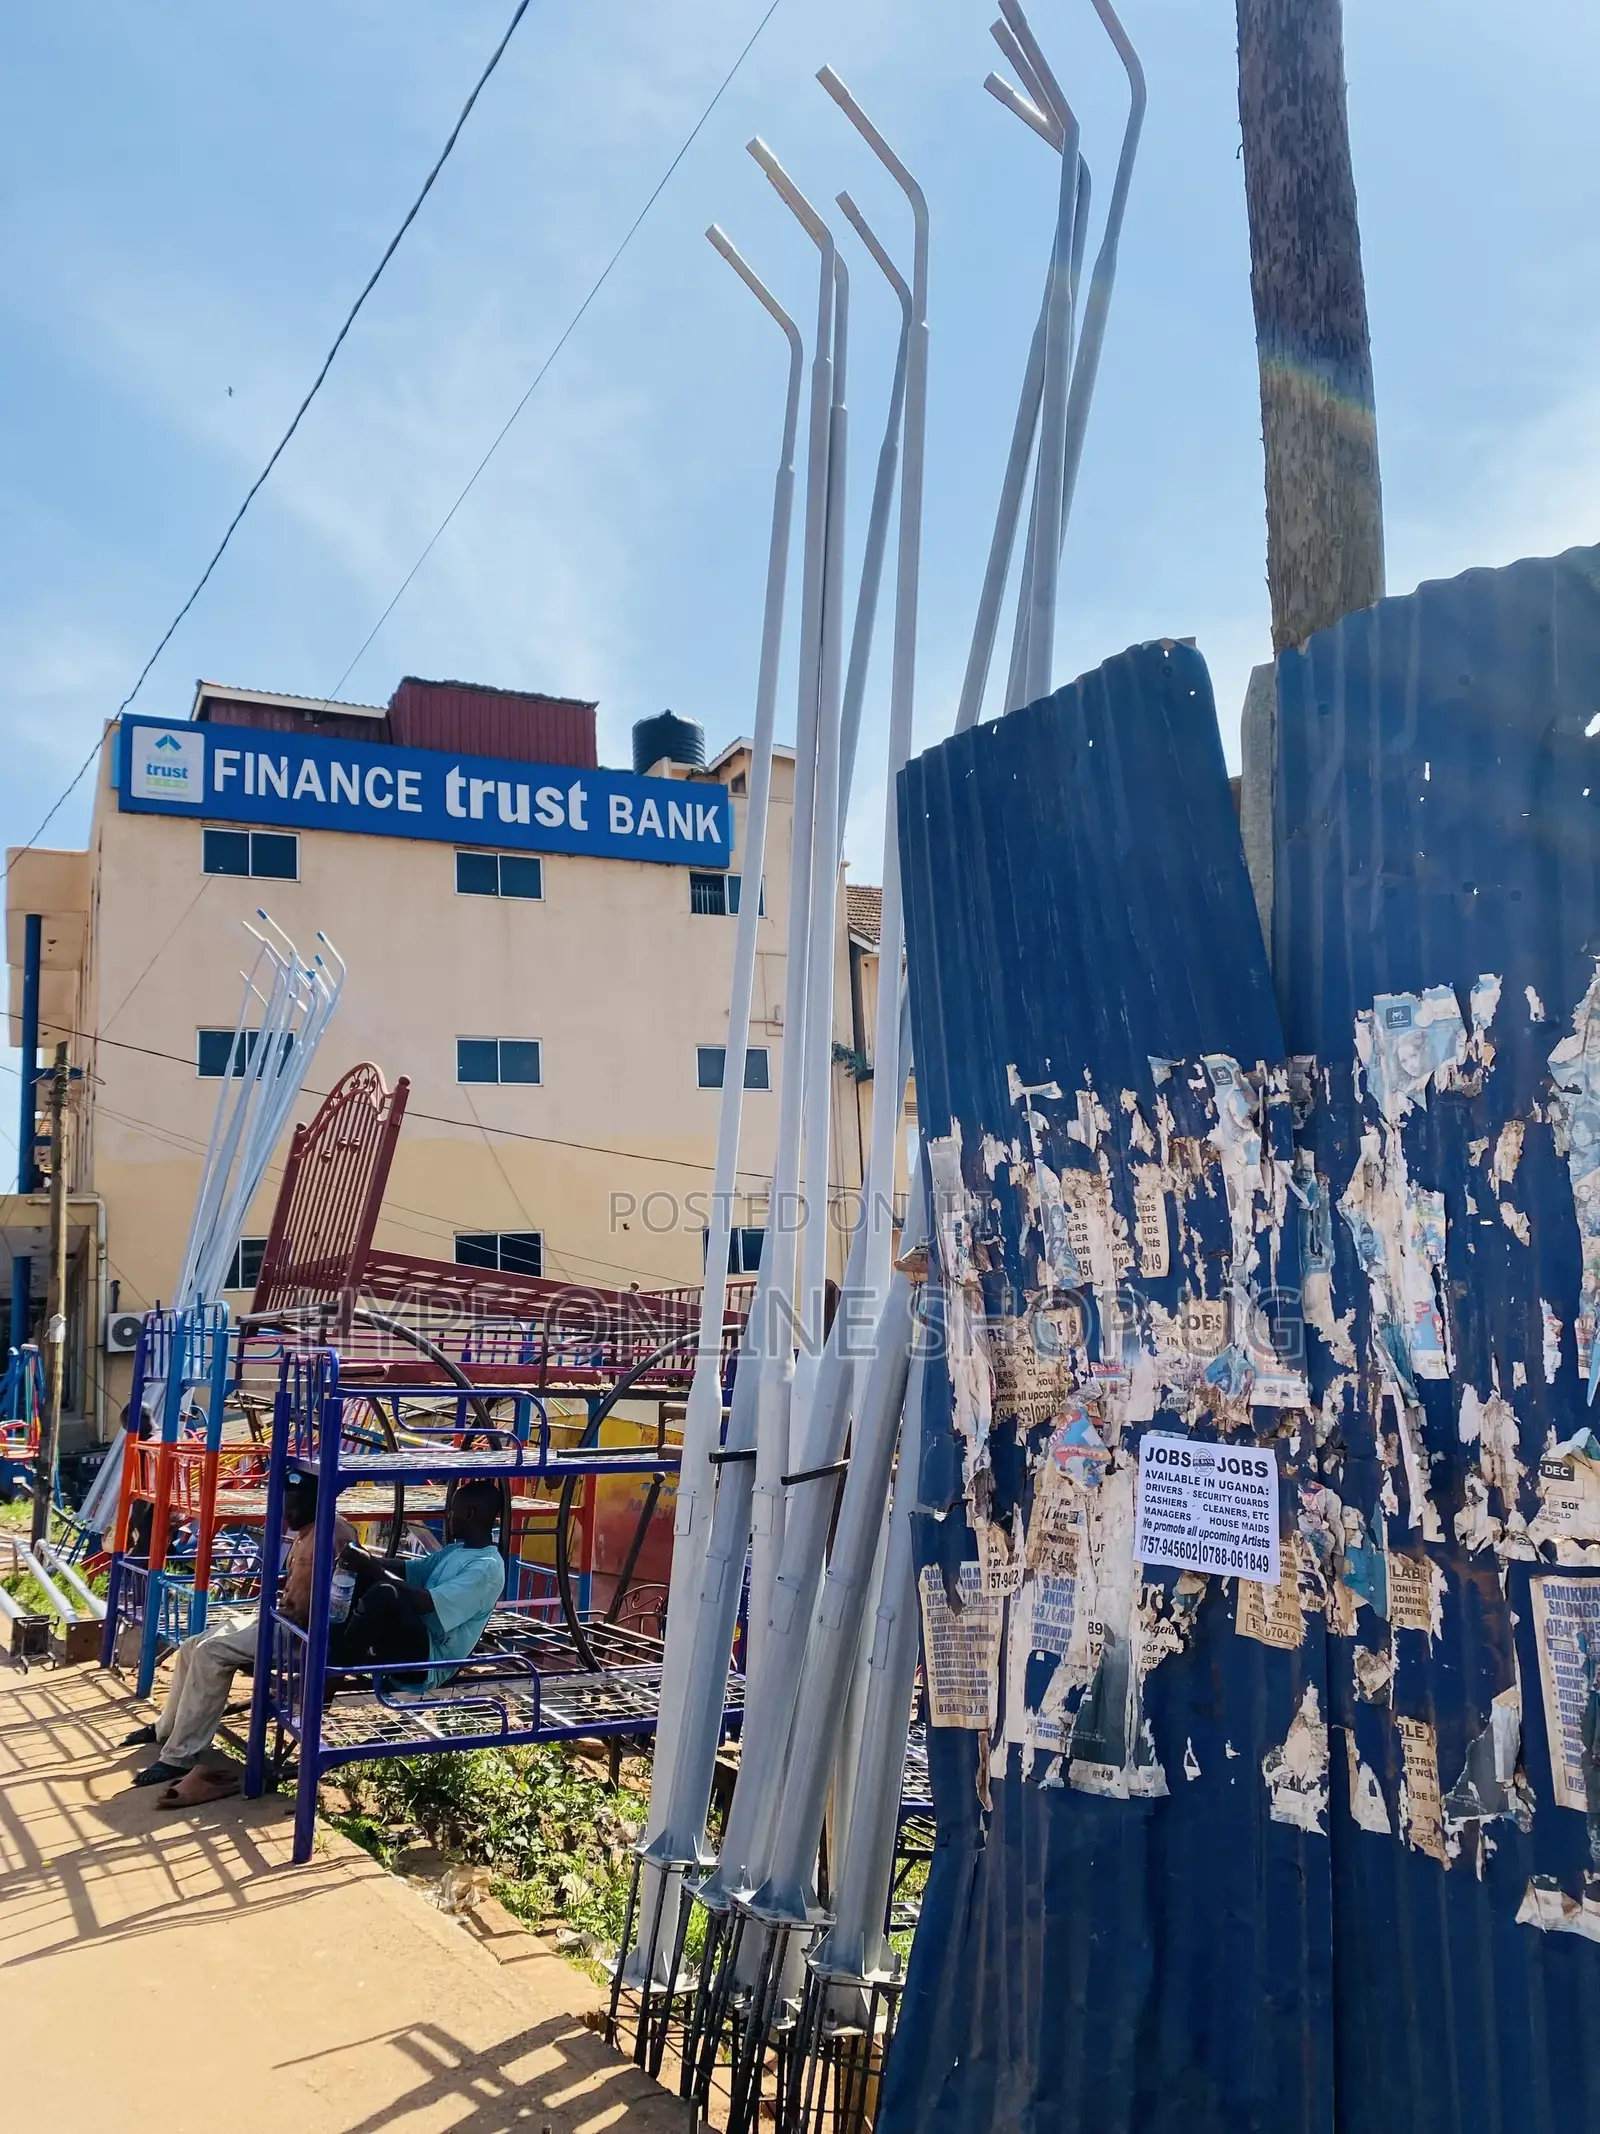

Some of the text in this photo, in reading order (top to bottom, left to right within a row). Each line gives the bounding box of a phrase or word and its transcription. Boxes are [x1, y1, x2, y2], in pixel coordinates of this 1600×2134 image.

[146, 762, 188, 779] trust
[213, 748, 722, 844] FINANCE trust BANK
[1145, 1447, 1269, 1478] JOBS JOBS
[1545, 1465, 1569, 1477] DEC
[1145, 1469, 1269, 1496] AVAILABLE IN UGANDA:
[1145, 1482, 1183, 1496] DRIVERS
[1192, 1489, 1233, 1503] SECURITY
[1235, 1496, 1269, 1509] GUARDS
[1144, 1494, 1188, 1509] CASHIERS
[1203, 1503, 1250, 1520] CLEANERS,
[1252, 1510, 1270, 1521] ETC
[1144, 1506, 1192, 1521] MANAGERS
[1209, 1516, 1239, 1529] HOUSE
[1241, 1521, 1269, 1534] MAIDS
[1153, 1519, 1186, 1535] promote
[1187, 1525, 1198, 1537] all
[1199, 1528, 1240, 1546] upcoming
[1241, 1533, 1270, 1549] Artists
[1202, 1544, 1269, 1573] 0788-061849
